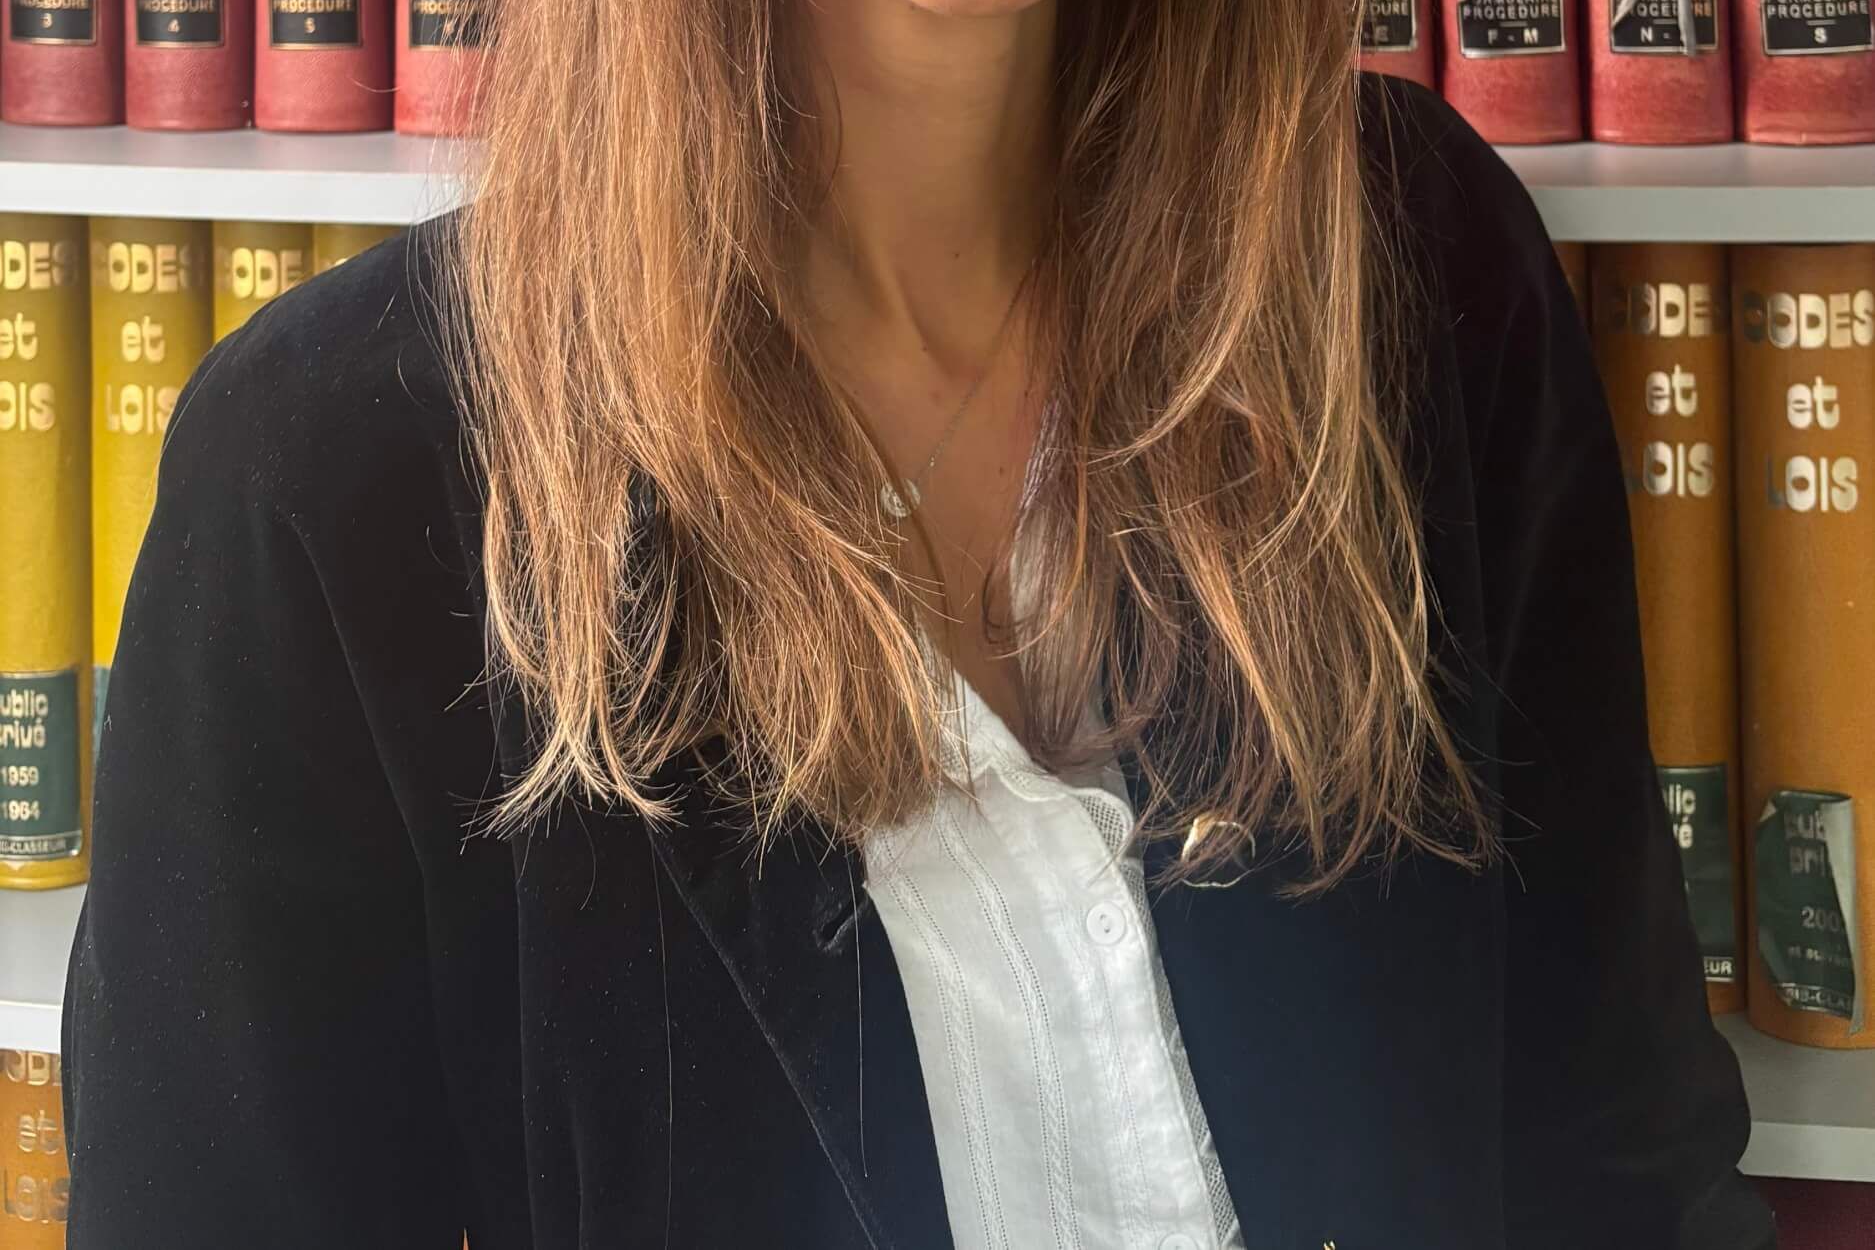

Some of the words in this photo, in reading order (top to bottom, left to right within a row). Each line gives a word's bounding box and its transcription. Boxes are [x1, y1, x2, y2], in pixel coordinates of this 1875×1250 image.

[1523, 28, 1539, 44] M
[1641, 26, 1653, 42] N
[231, 247, 303, 299] ODE
[0, 312, 38, 360] et
[121, 315, 165, 362] et
[1645, 364, 1697, 417] et
[1786, 375, 1840, 430] et
[1642, 440, 1714, 498] OIS
[0, 717, 46, 749] rivé
[2, 765, 39, 787] 1959
[17, 1110, 59, 1155] et
